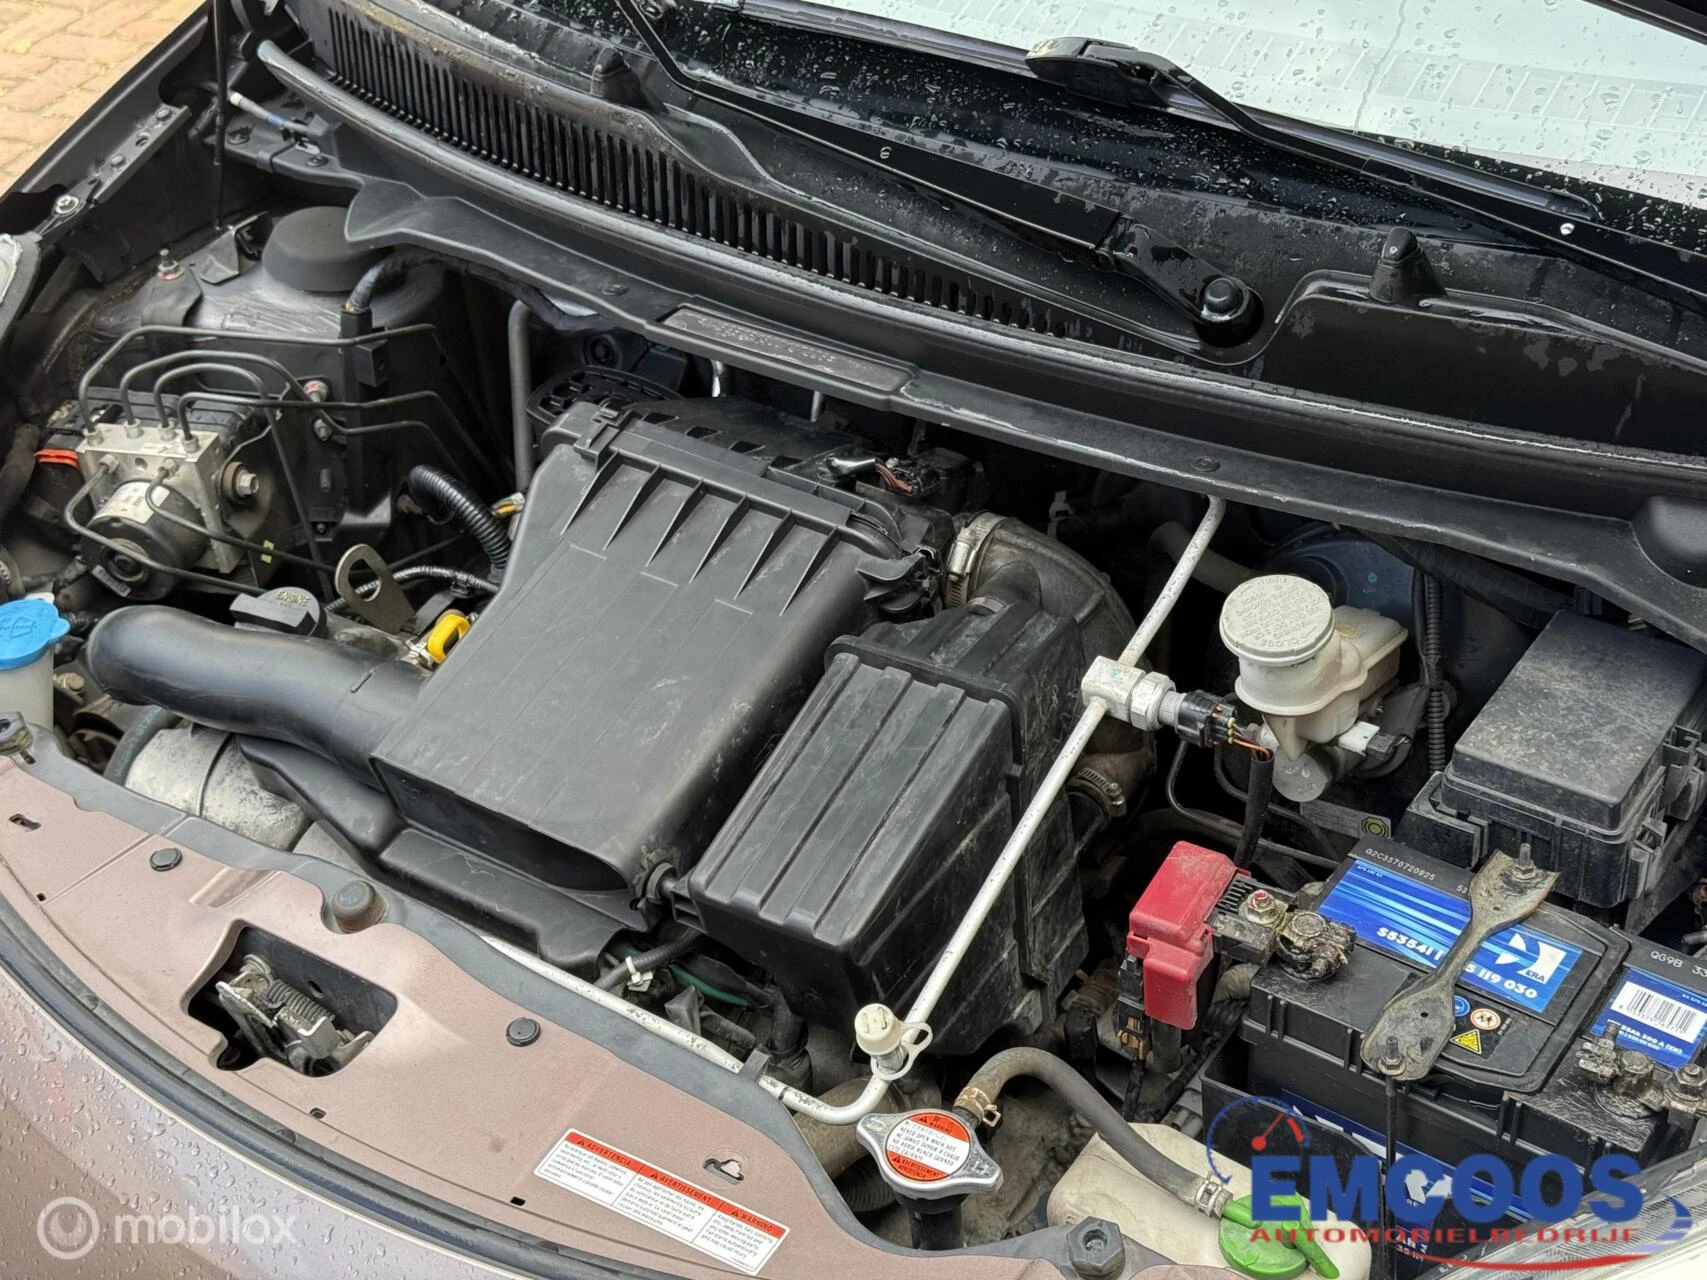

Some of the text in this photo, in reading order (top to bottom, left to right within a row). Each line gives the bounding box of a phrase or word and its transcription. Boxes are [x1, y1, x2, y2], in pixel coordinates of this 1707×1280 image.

[275, 591, 312, 607] ENGINE
[1650, 950, 1684, 968] QG9B
[1504, 979, 1537, 999] 030
[915, 1131, 929, 1142] OPEN
[585, 1141, 633, 1166] ADVERTENCIA
[658, 1175, 713, 1203] AVERTISSEMENT
[739, 1212, 774, 1232] WARNING
